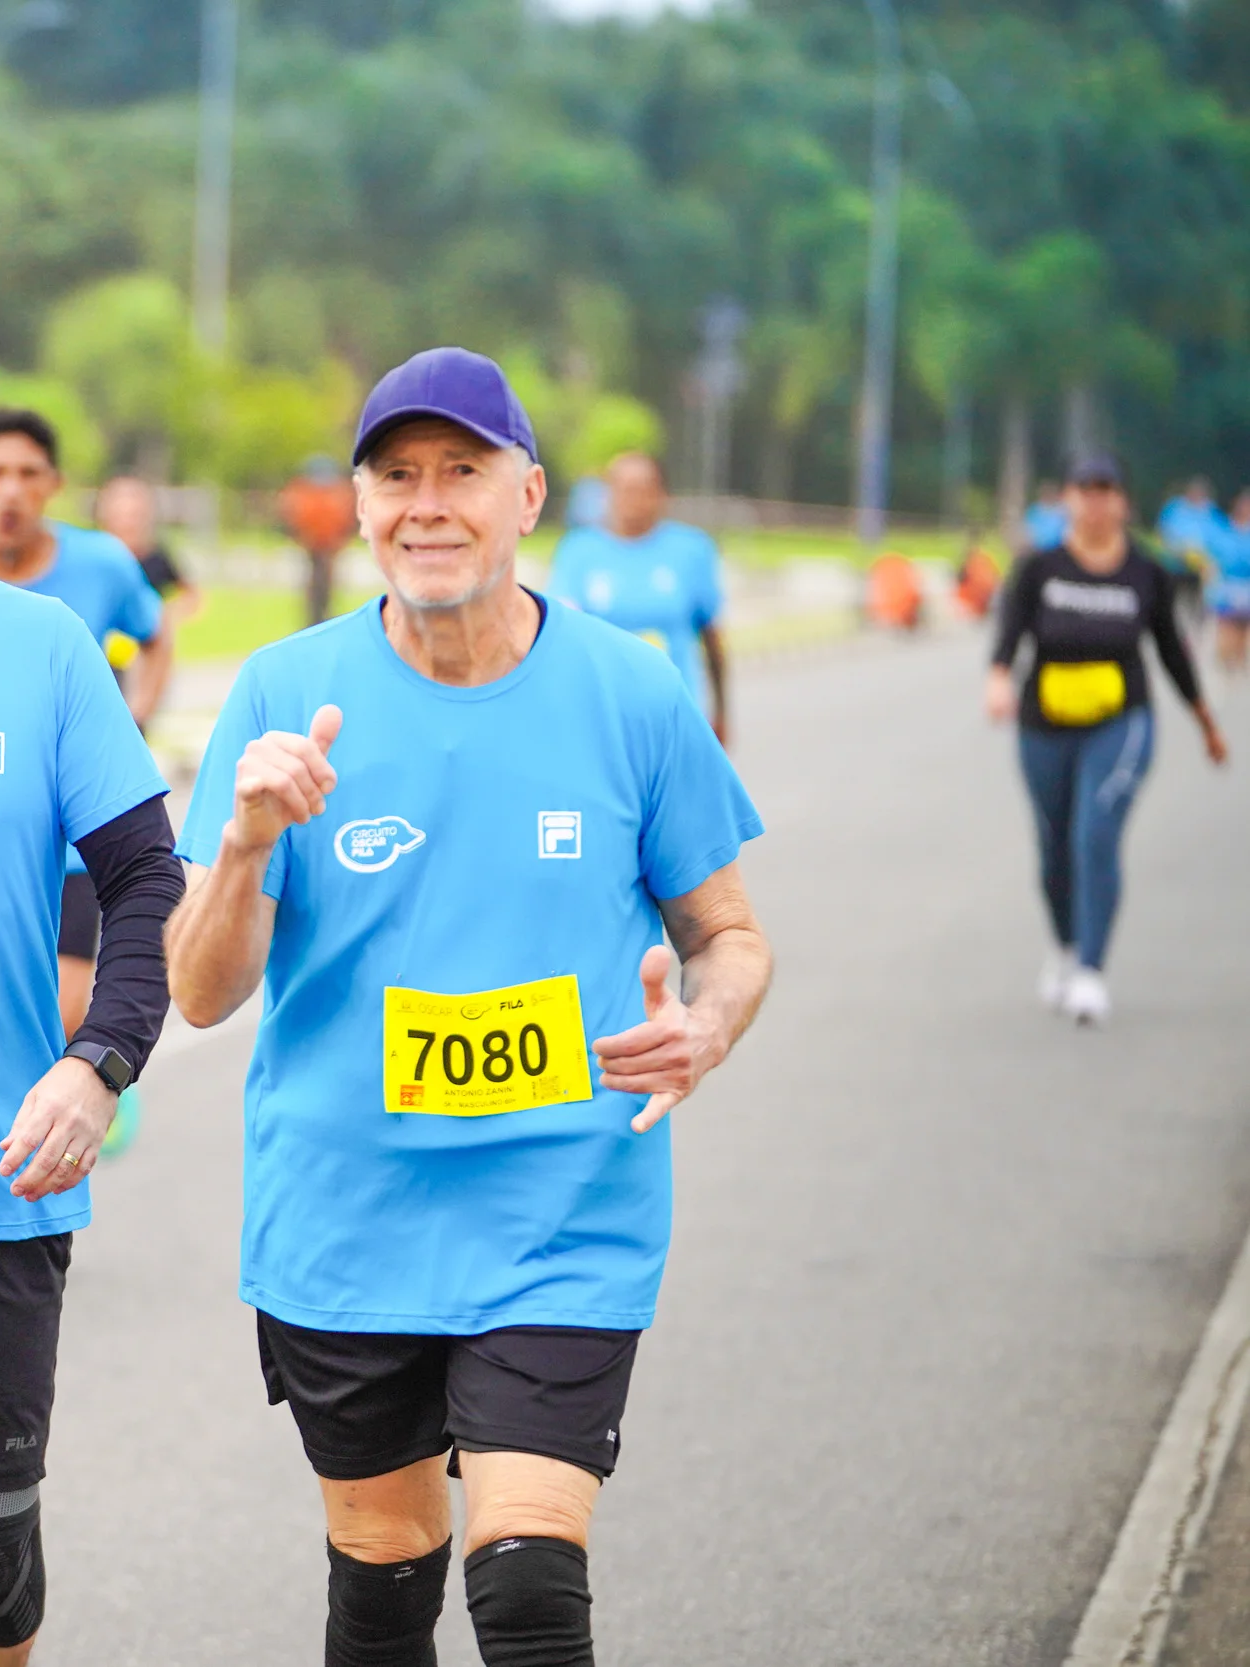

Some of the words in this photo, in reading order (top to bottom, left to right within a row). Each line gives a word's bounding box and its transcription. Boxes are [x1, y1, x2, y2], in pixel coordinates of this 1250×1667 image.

[351, 826, 398, 839] CIRCUITO
[351, 836, 387, 848] OSCAR
[499, 999, 524, 1011] FILA
[407, 1023, 548, 1085] 7080
[5, 1434, 38, 1451] FILA
